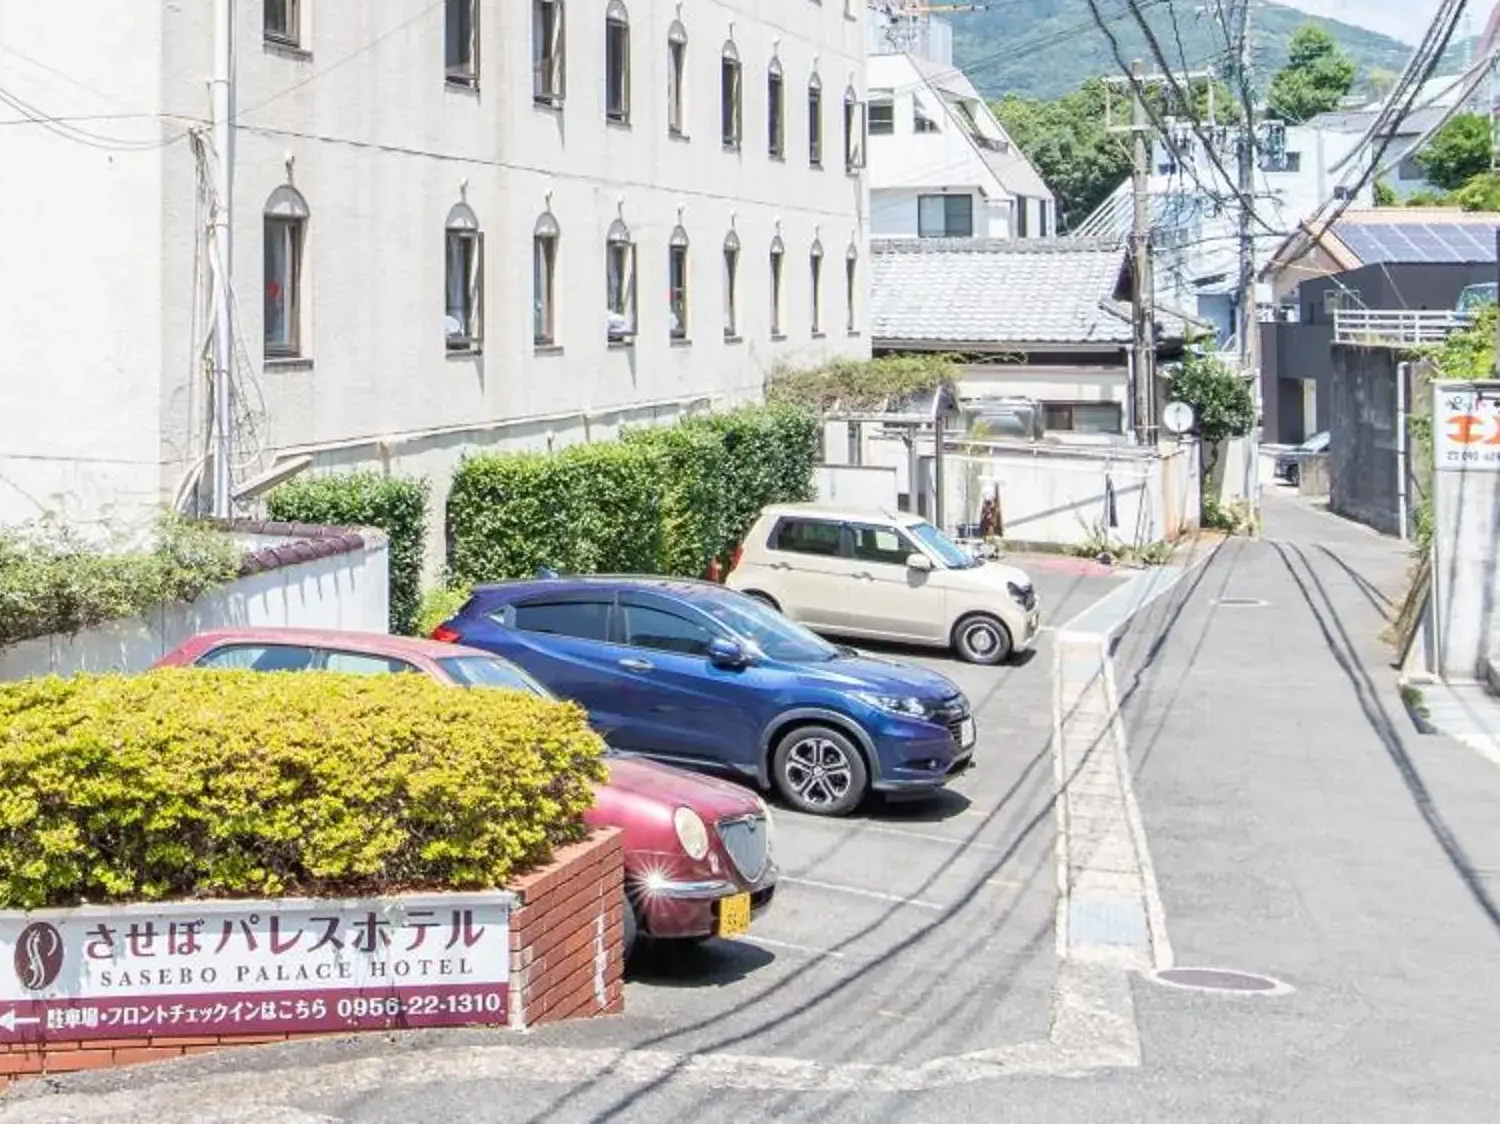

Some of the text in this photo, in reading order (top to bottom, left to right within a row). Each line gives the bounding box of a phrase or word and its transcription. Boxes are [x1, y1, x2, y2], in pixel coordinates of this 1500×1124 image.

[85, 909, 485, 960] させぼパレスホテル
[100, 957, 474, 987] SASEBO PALACE HOTEL
[336, 992, 501, 1018] 0956-22-1310
